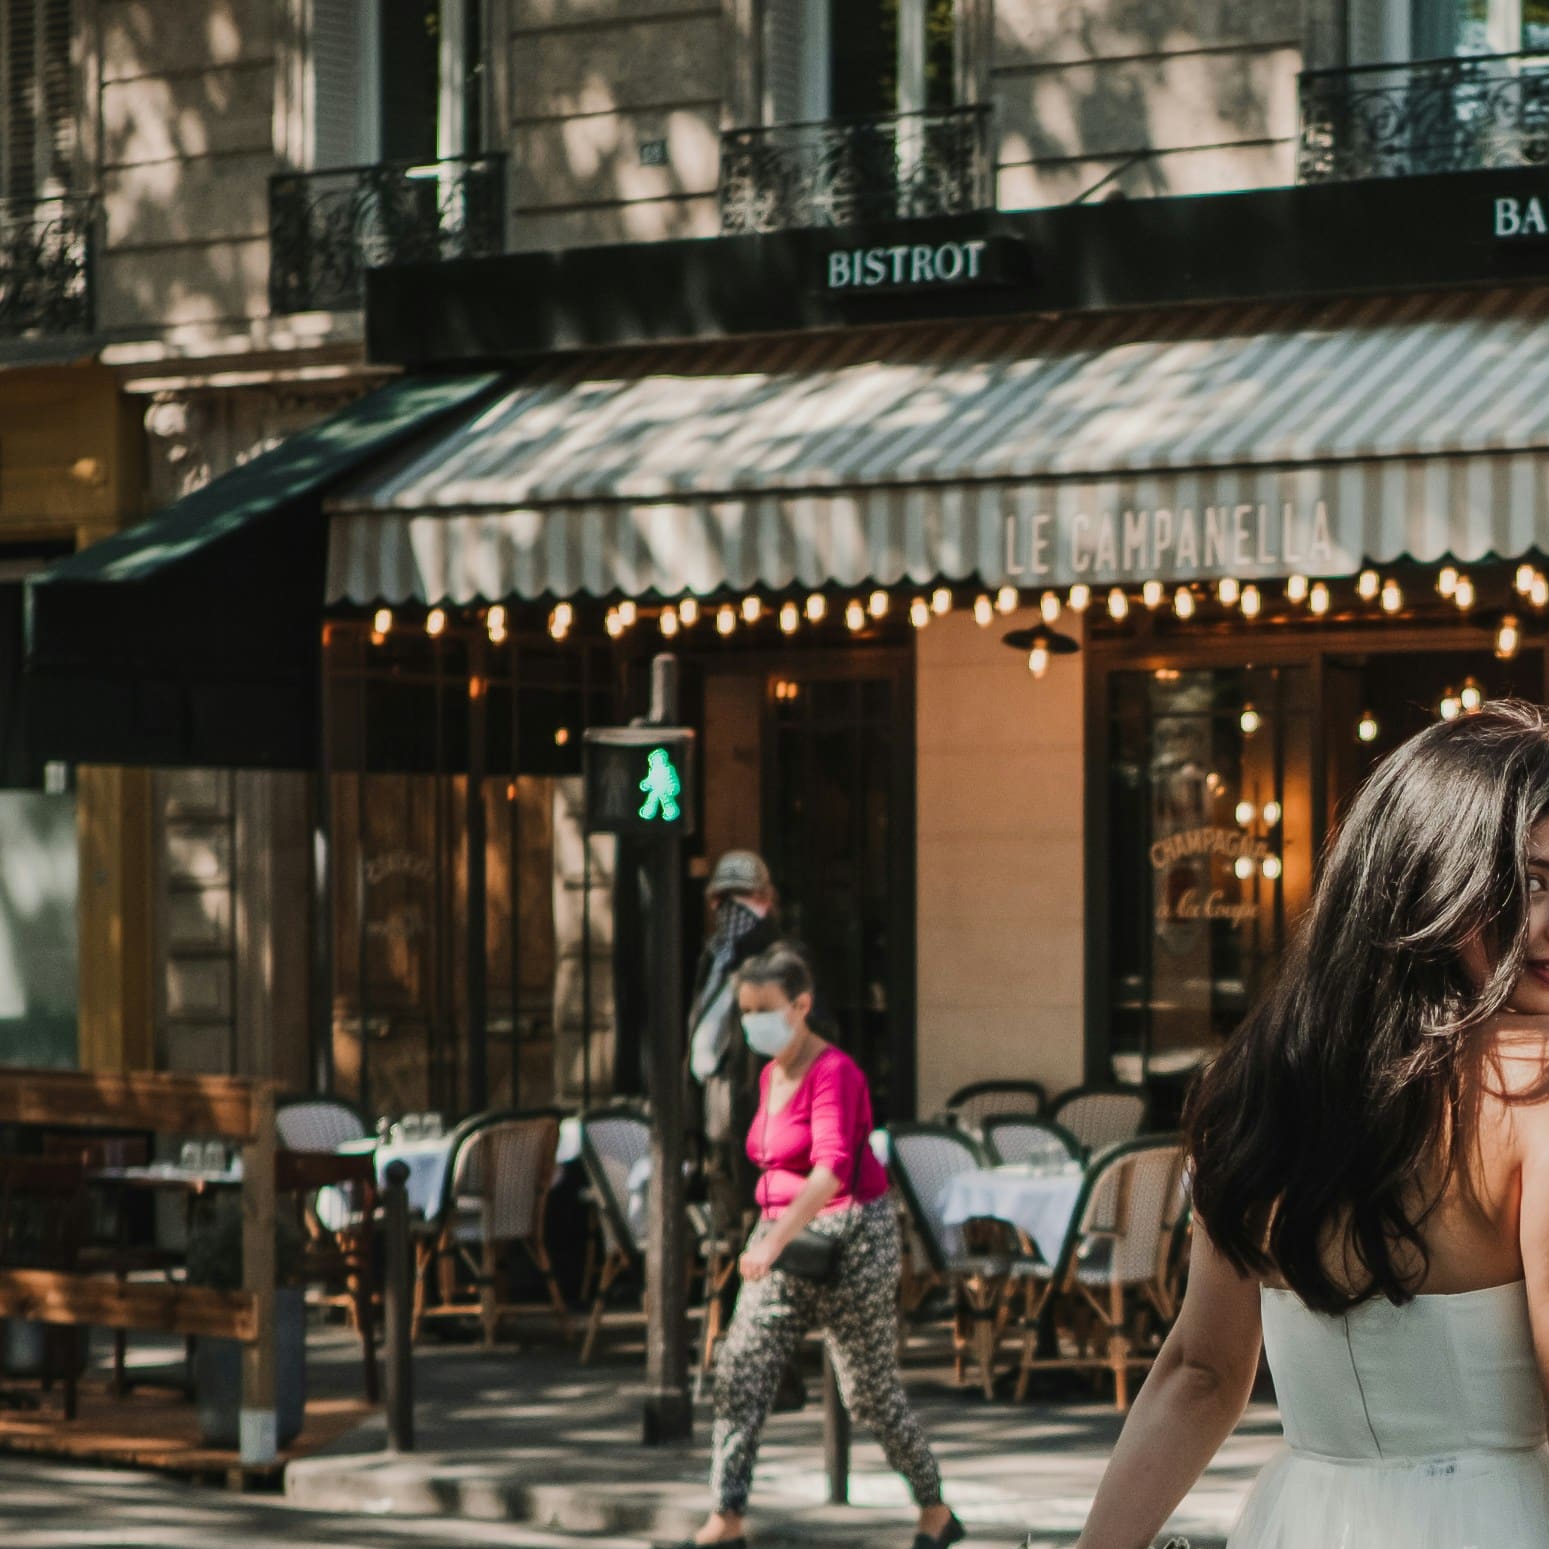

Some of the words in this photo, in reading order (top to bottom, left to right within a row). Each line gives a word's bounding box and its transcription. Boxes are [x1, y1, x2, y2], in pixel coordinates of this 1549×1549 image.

[829, 240, 986, 288] BISTROT
[1005, 513, 1051, 575] LE
[1070, 501, 1333, 574] CAMPANELLA
